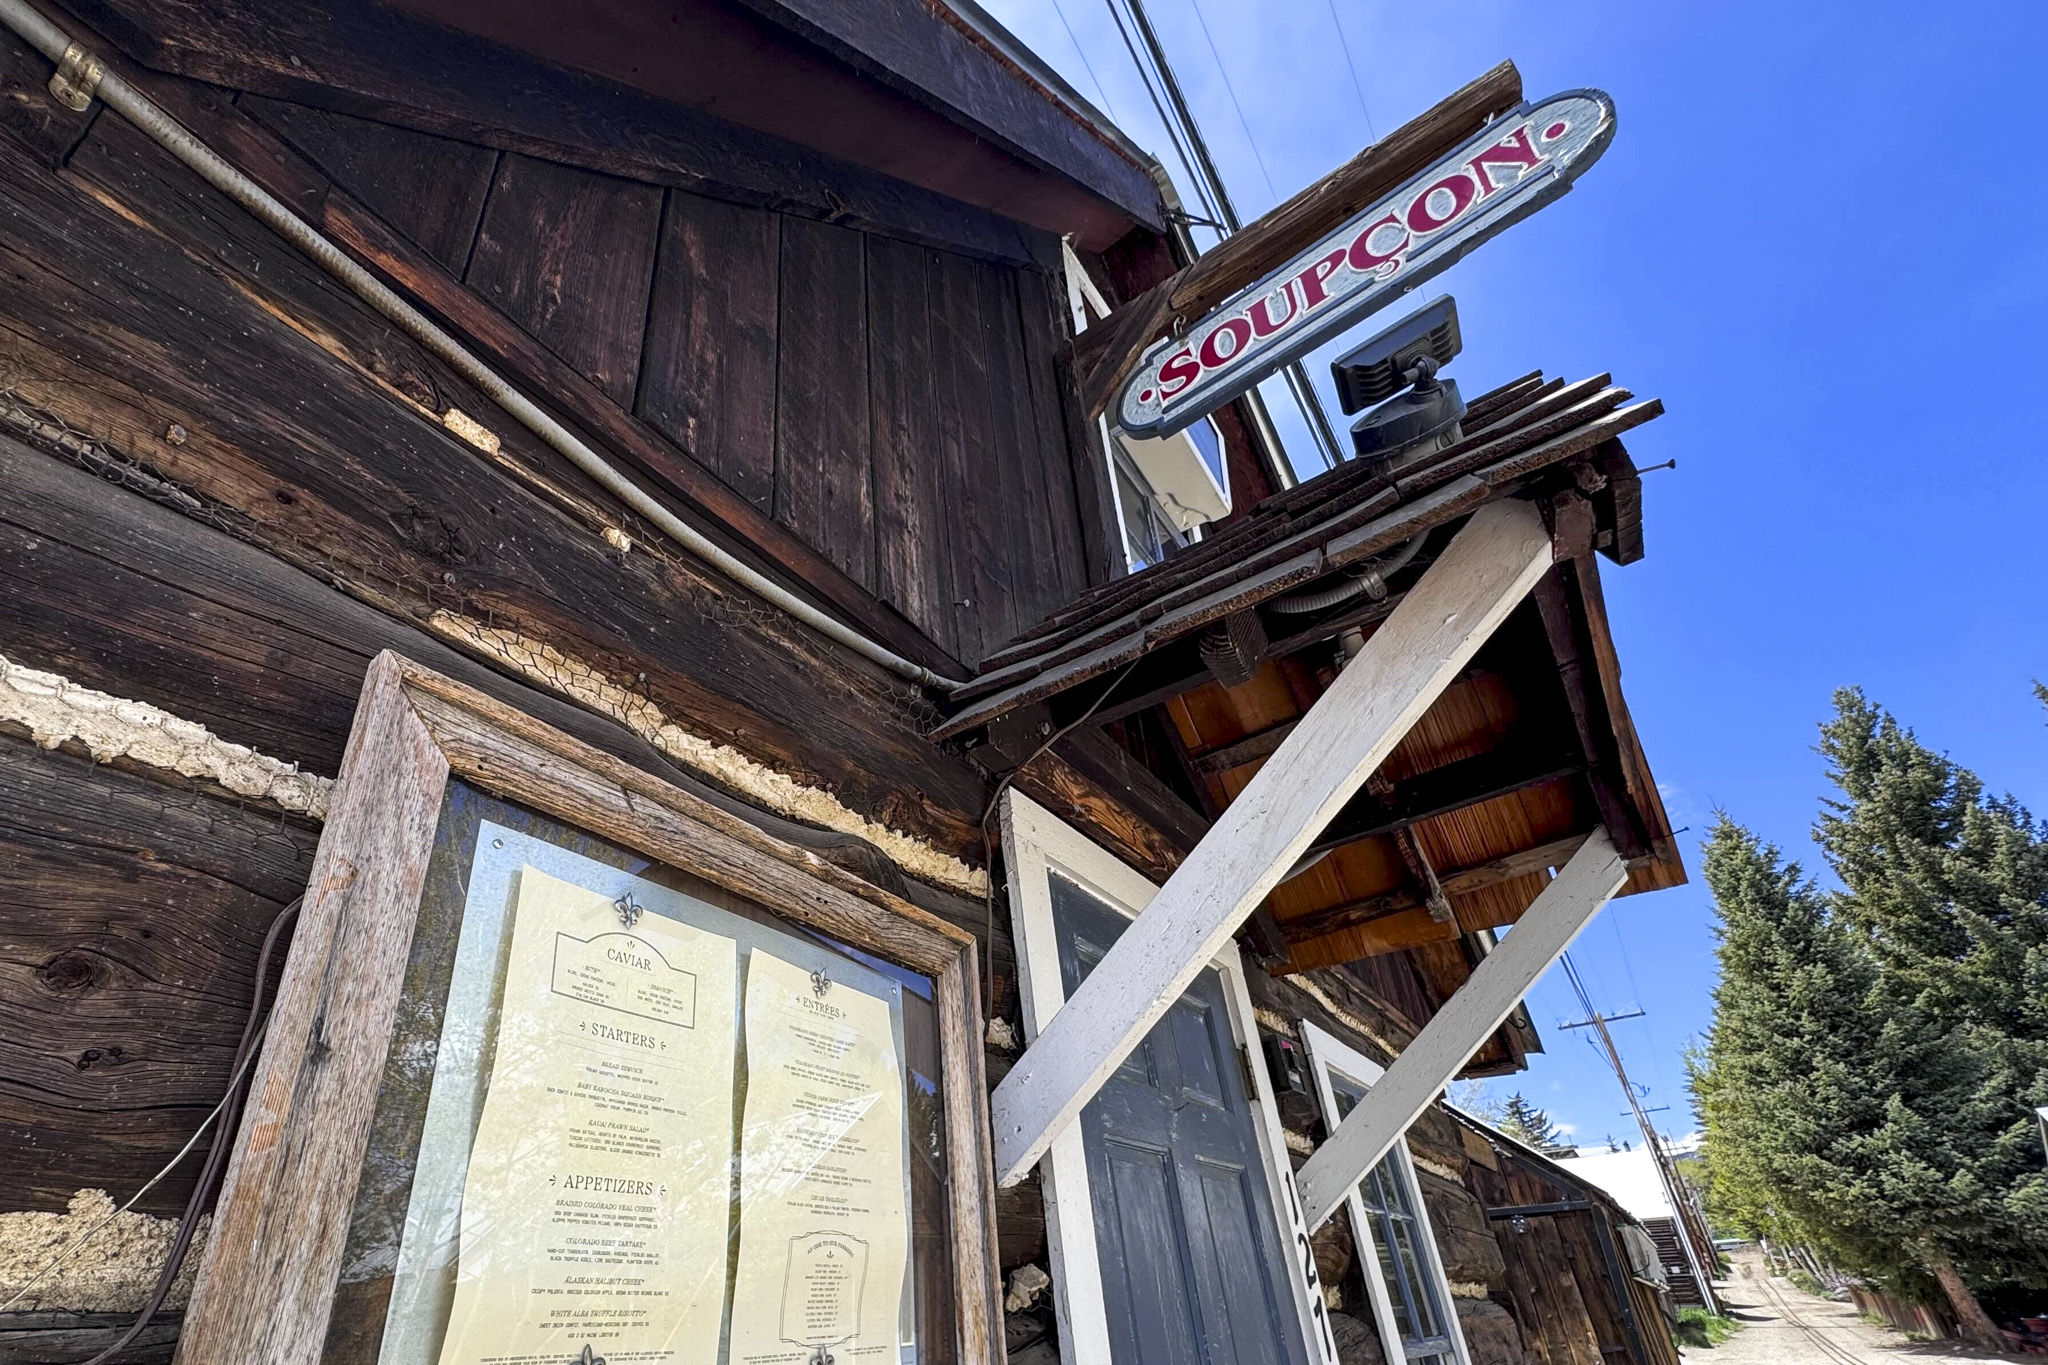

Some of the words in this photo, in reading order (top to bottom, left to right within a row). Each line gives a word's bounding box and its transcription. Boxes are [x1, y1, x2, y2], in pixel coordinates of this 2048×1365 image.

[1156, 123, 1549, 402] SOUPÇON
[607, 948, 652, 972] CAVIAR
[591, 1022, 655, 1050] STARTERS
[564, 1174, 653, 1196] APPETIZERS
[582, 1201, 616, 1210] COLORADO
[617, 1204, 632, 1212] VEAL
[565, 1237, 599, 1246] COLORADO
